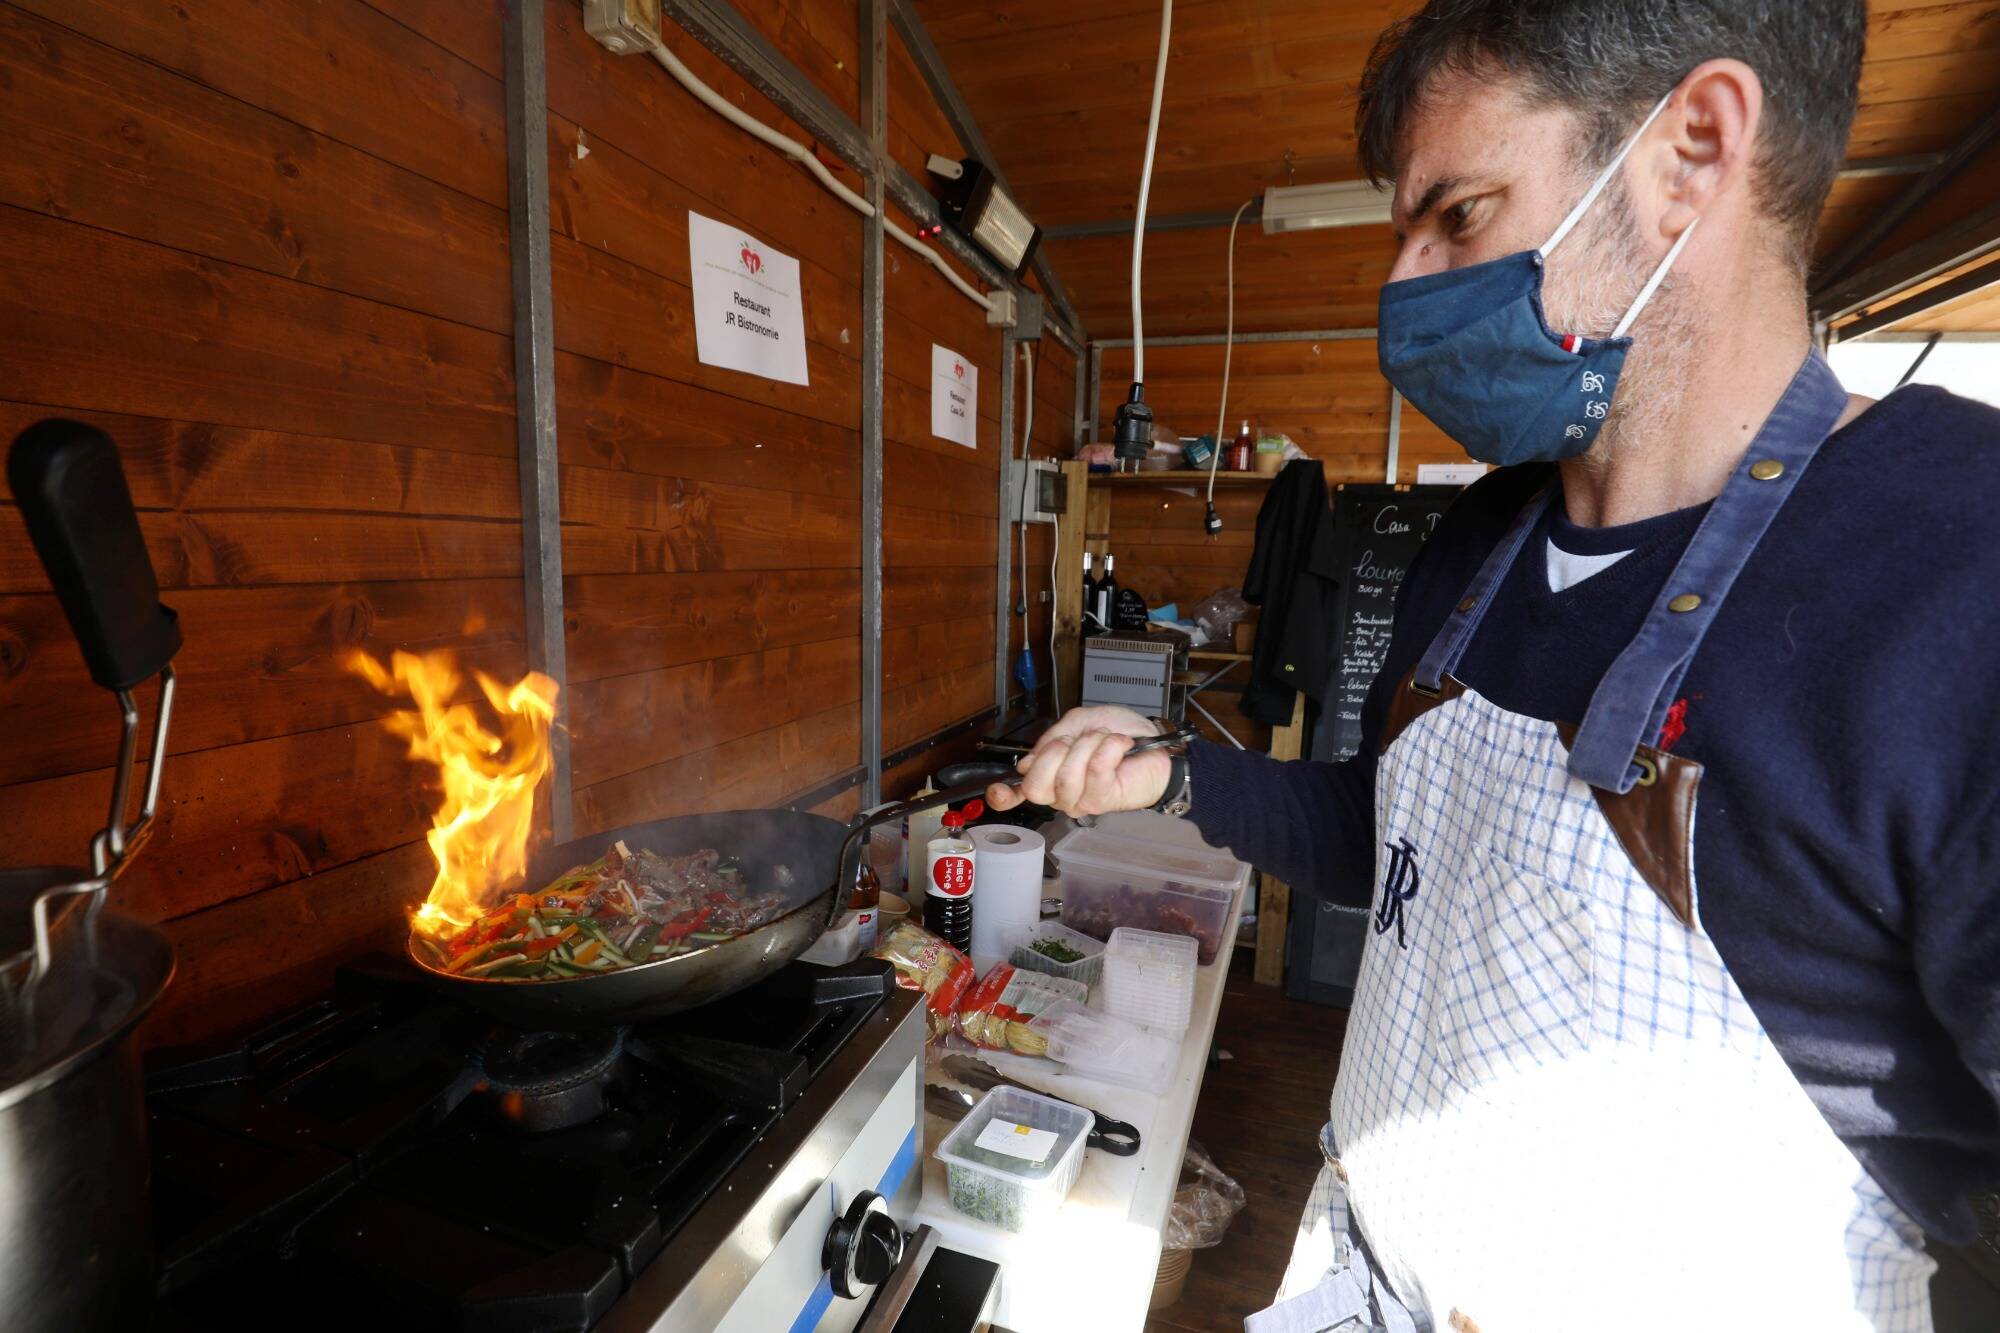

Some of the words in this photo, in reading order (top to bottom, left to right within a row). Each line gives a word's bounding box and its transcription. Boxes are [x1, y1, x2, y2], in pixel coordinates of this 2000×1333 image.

[733, 291, 771, 318] Restaurant
[725, 311, 736, 327] JR
[737, 314, 780, 341] Bistronomie
